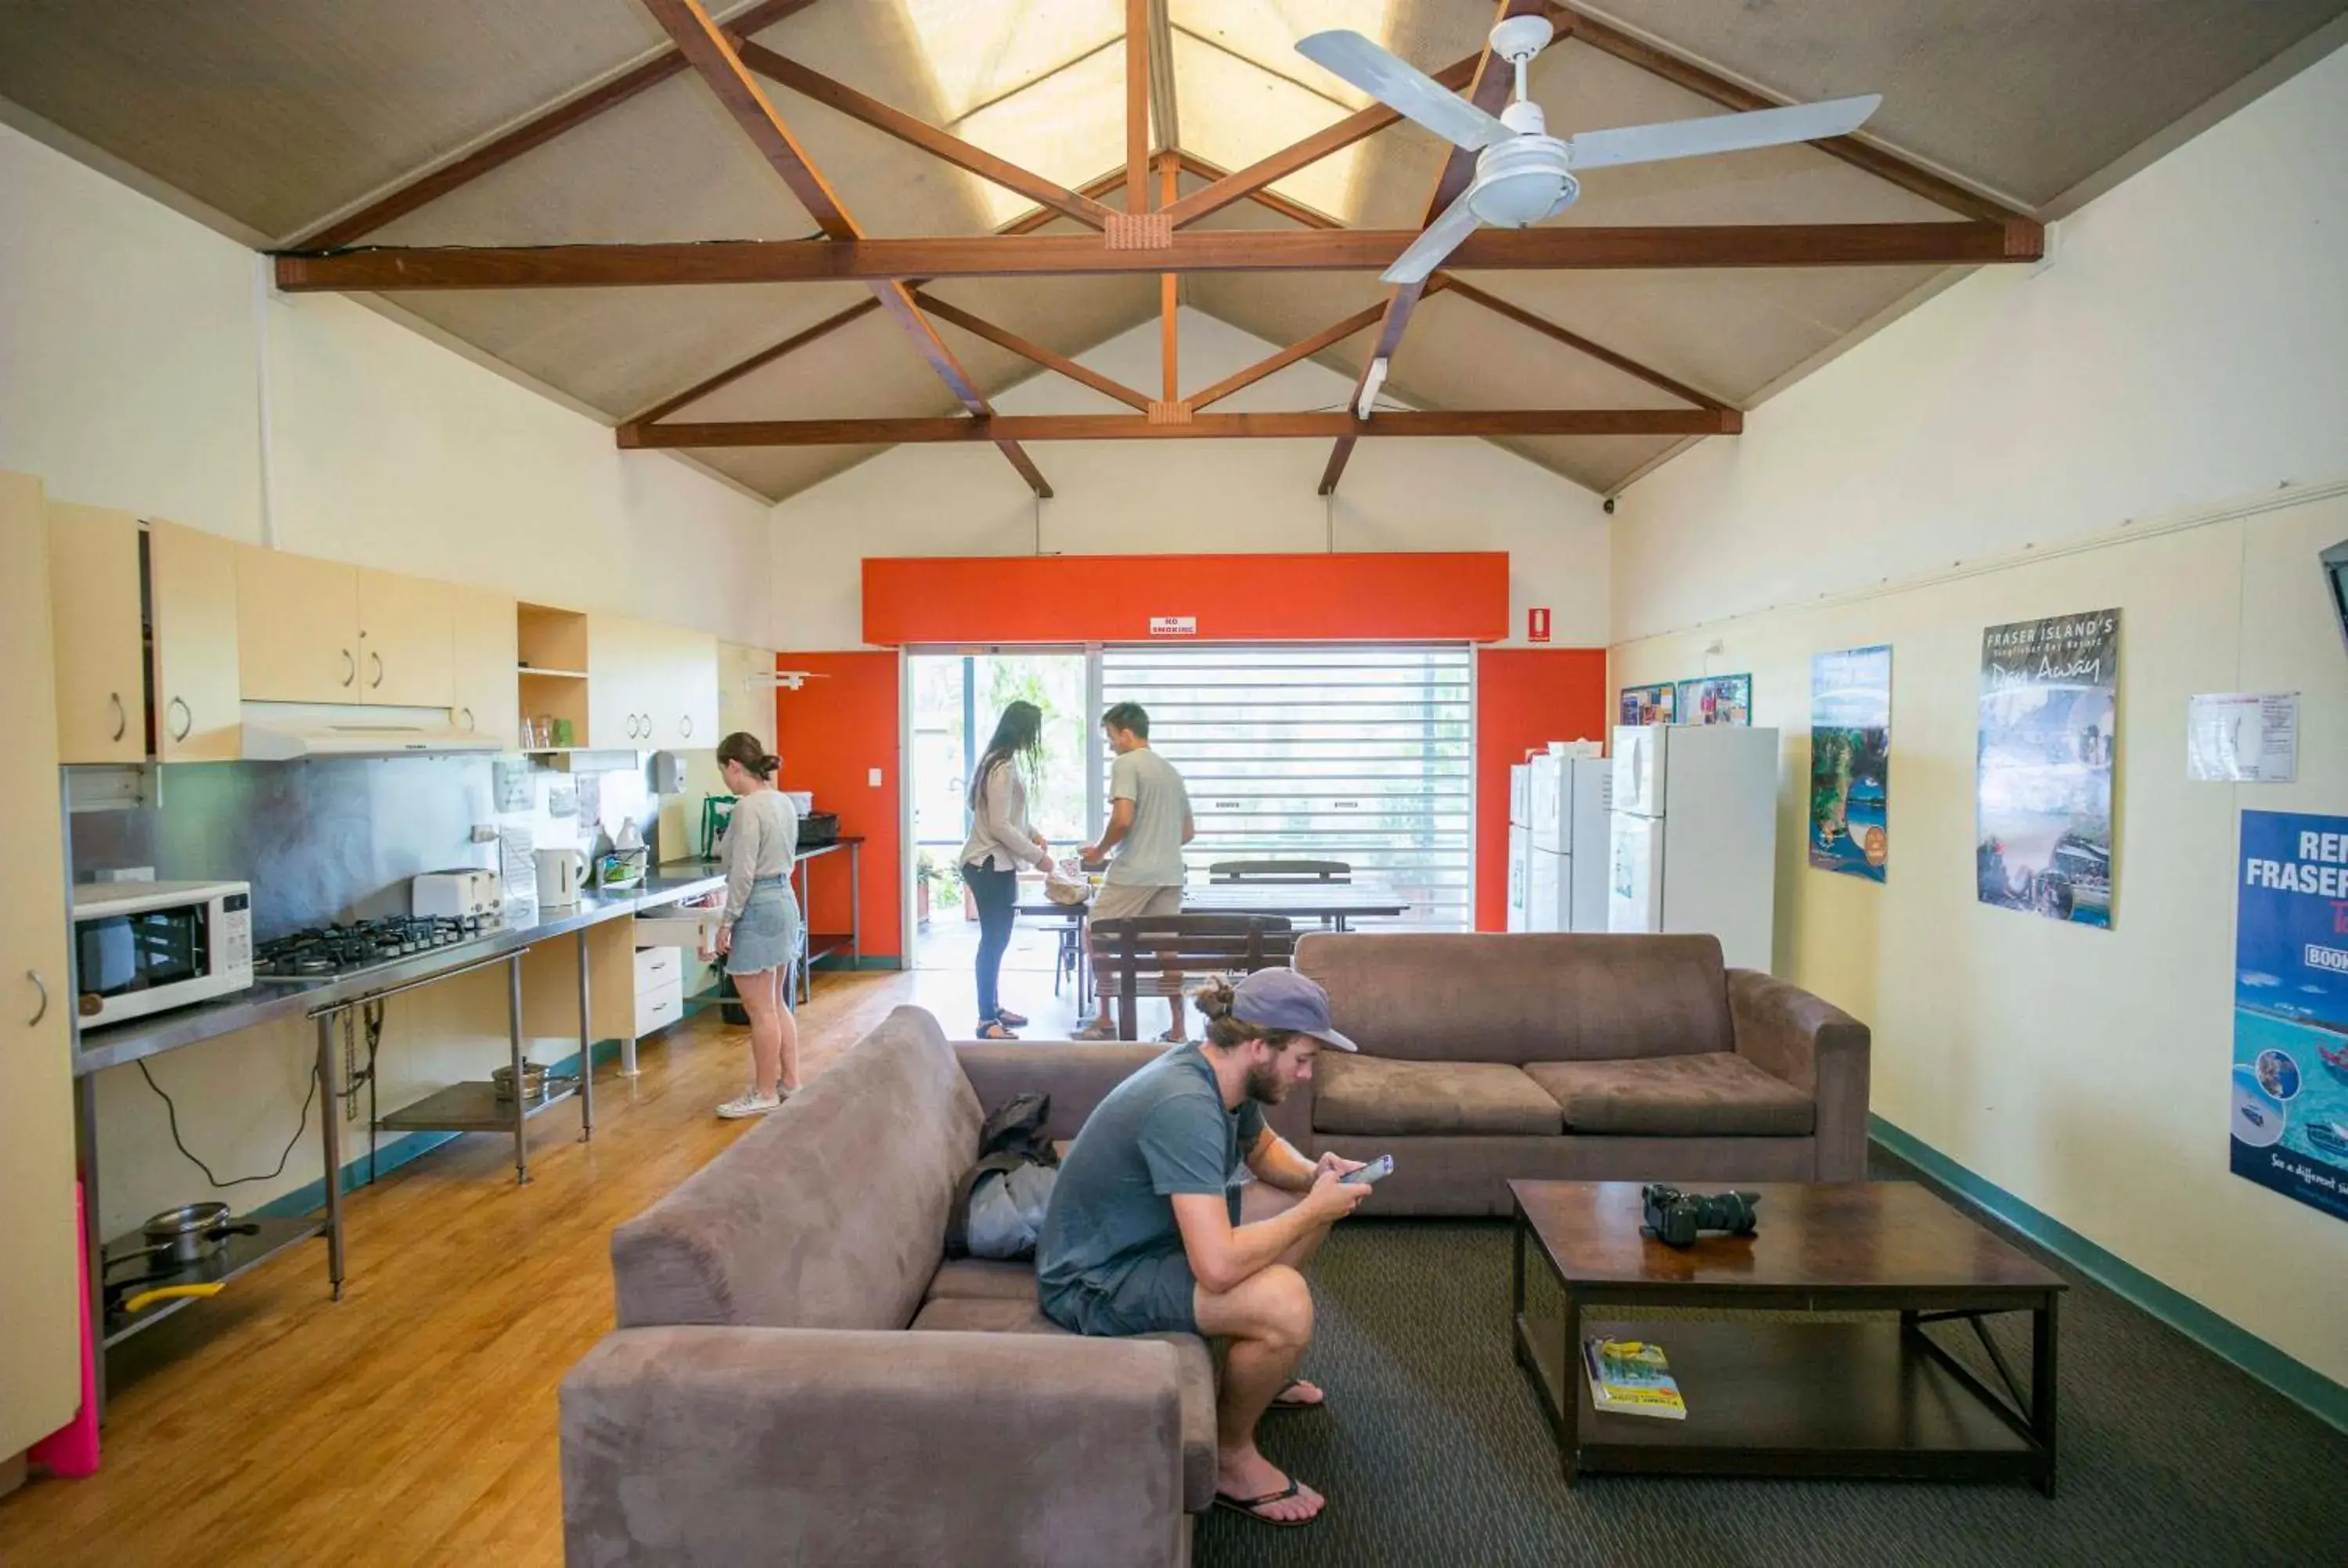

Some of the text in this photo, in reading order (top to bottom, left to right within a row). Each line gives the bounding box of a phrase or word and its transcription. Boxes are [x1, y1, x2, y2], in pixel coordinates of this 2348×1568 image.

[1987, 618, 2113, 649] FRASER ISLAND'S
[1992, 655, 2101, 690] Day Away
[2296, 1164, 2335, 1189] different
